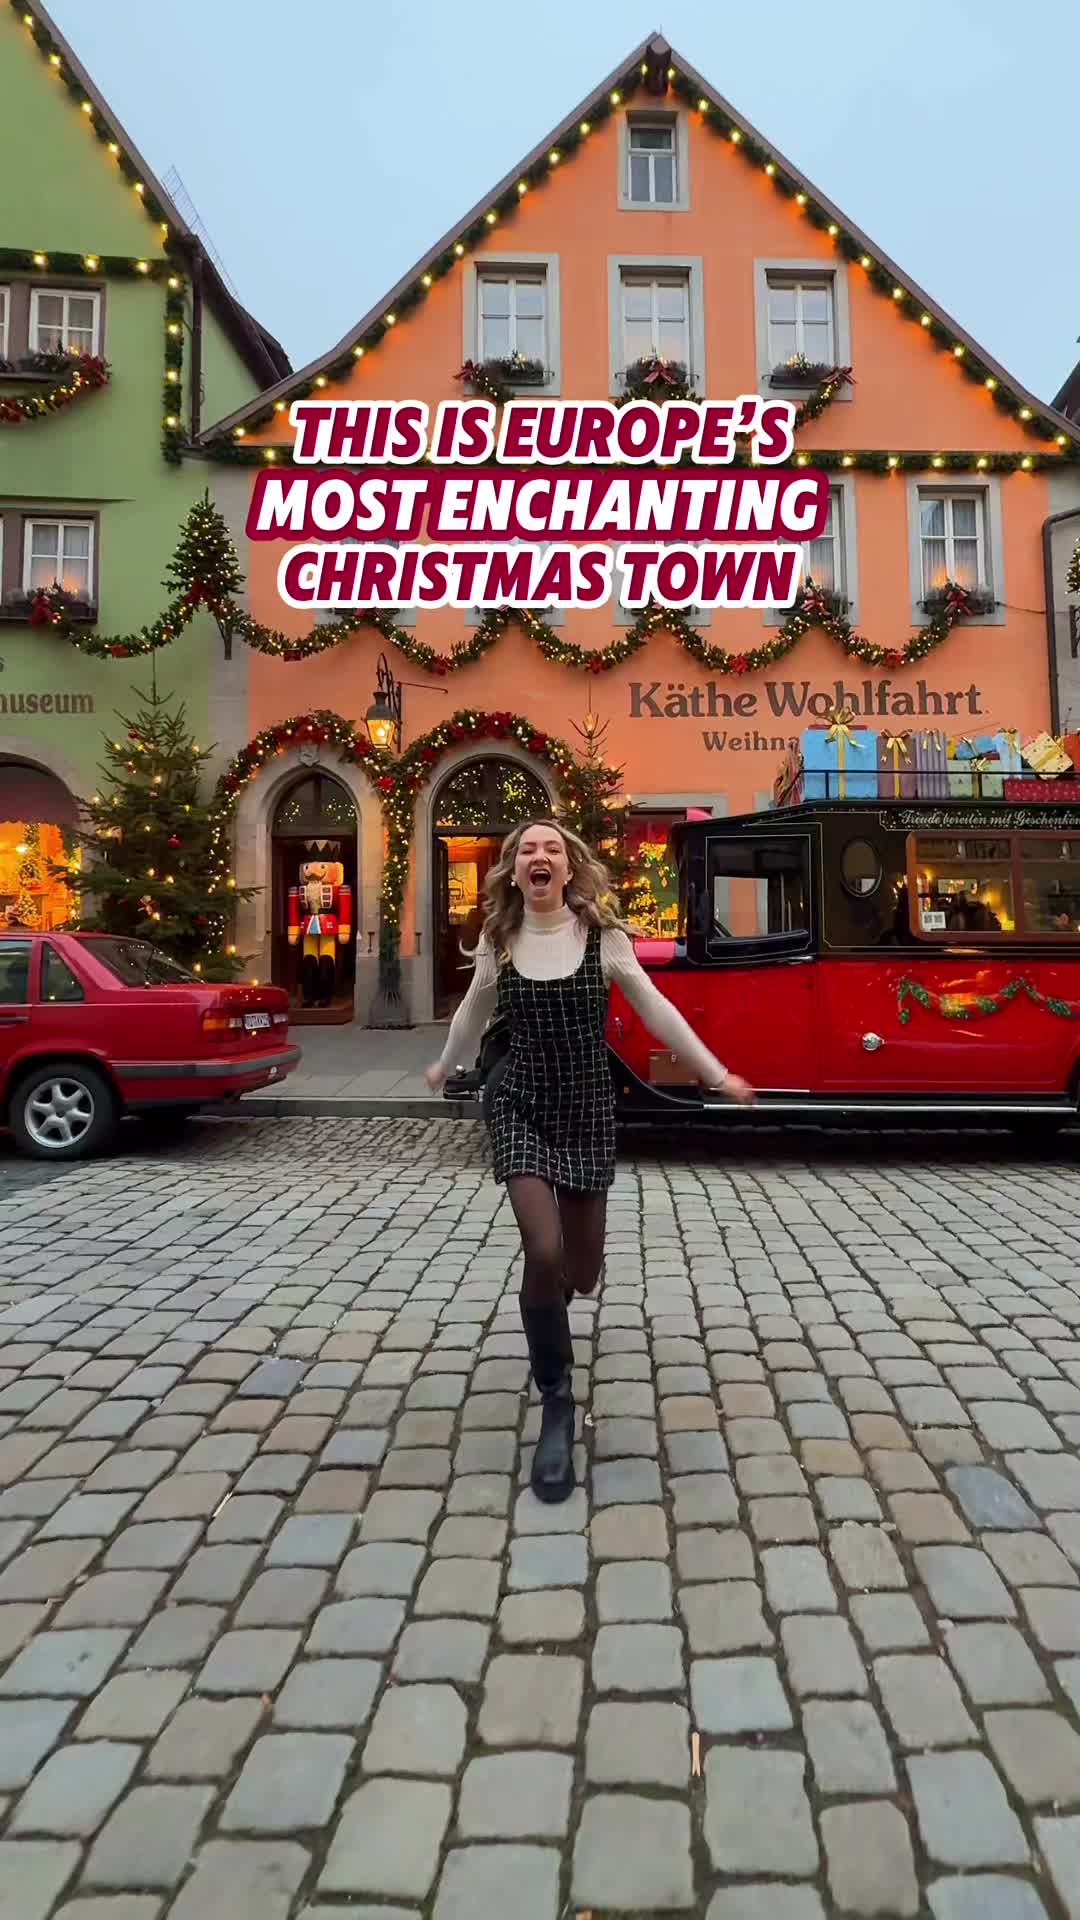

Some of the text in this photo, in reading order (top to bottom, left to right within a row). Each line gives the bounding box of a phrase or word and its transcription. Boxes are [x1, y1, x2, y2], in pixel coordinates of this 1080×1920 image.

[628, 679, 983, 718] Käthe Wohlfahrt
[989, 812, 1012, 825] mit
